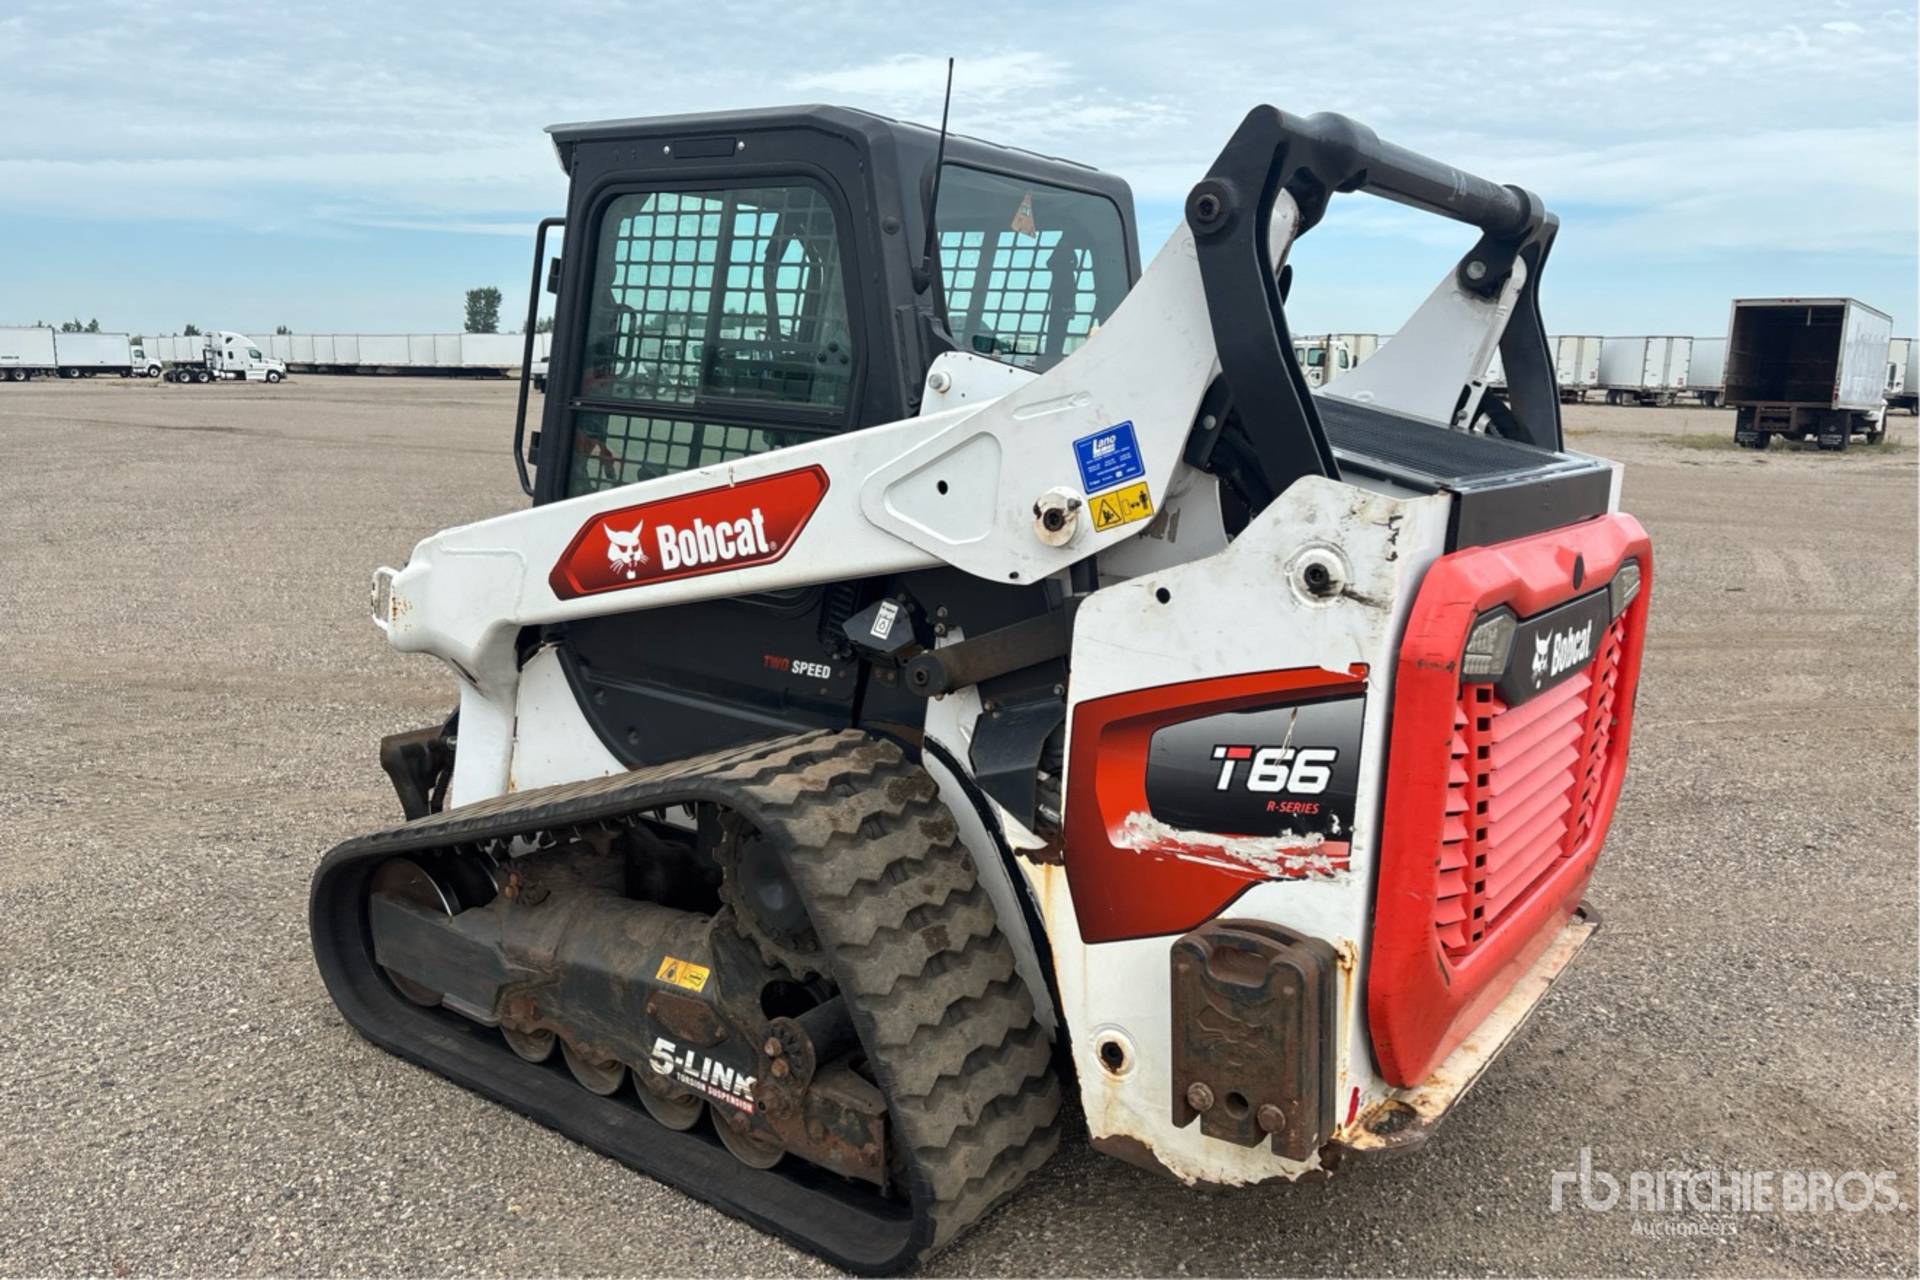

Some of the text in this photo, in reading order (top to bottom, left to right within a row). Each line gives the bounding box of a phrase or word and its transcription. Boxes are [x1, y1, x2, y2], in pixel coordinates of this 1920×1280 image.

[1092, 435, 1116, 457] Lano
[656, 508, 769, 570] Bobcat
[763, 655, 831, 679] TWO SPEED
[1551, 619, 1592, 677] Bobcat
[1212, 746, 1337, 795] T66
[1266, 800, 1319, 815] R-SERIES
[649, 1037, 757, 1101] 5-LINK
[707, 1085, 755, 1116] SUSPENSION
